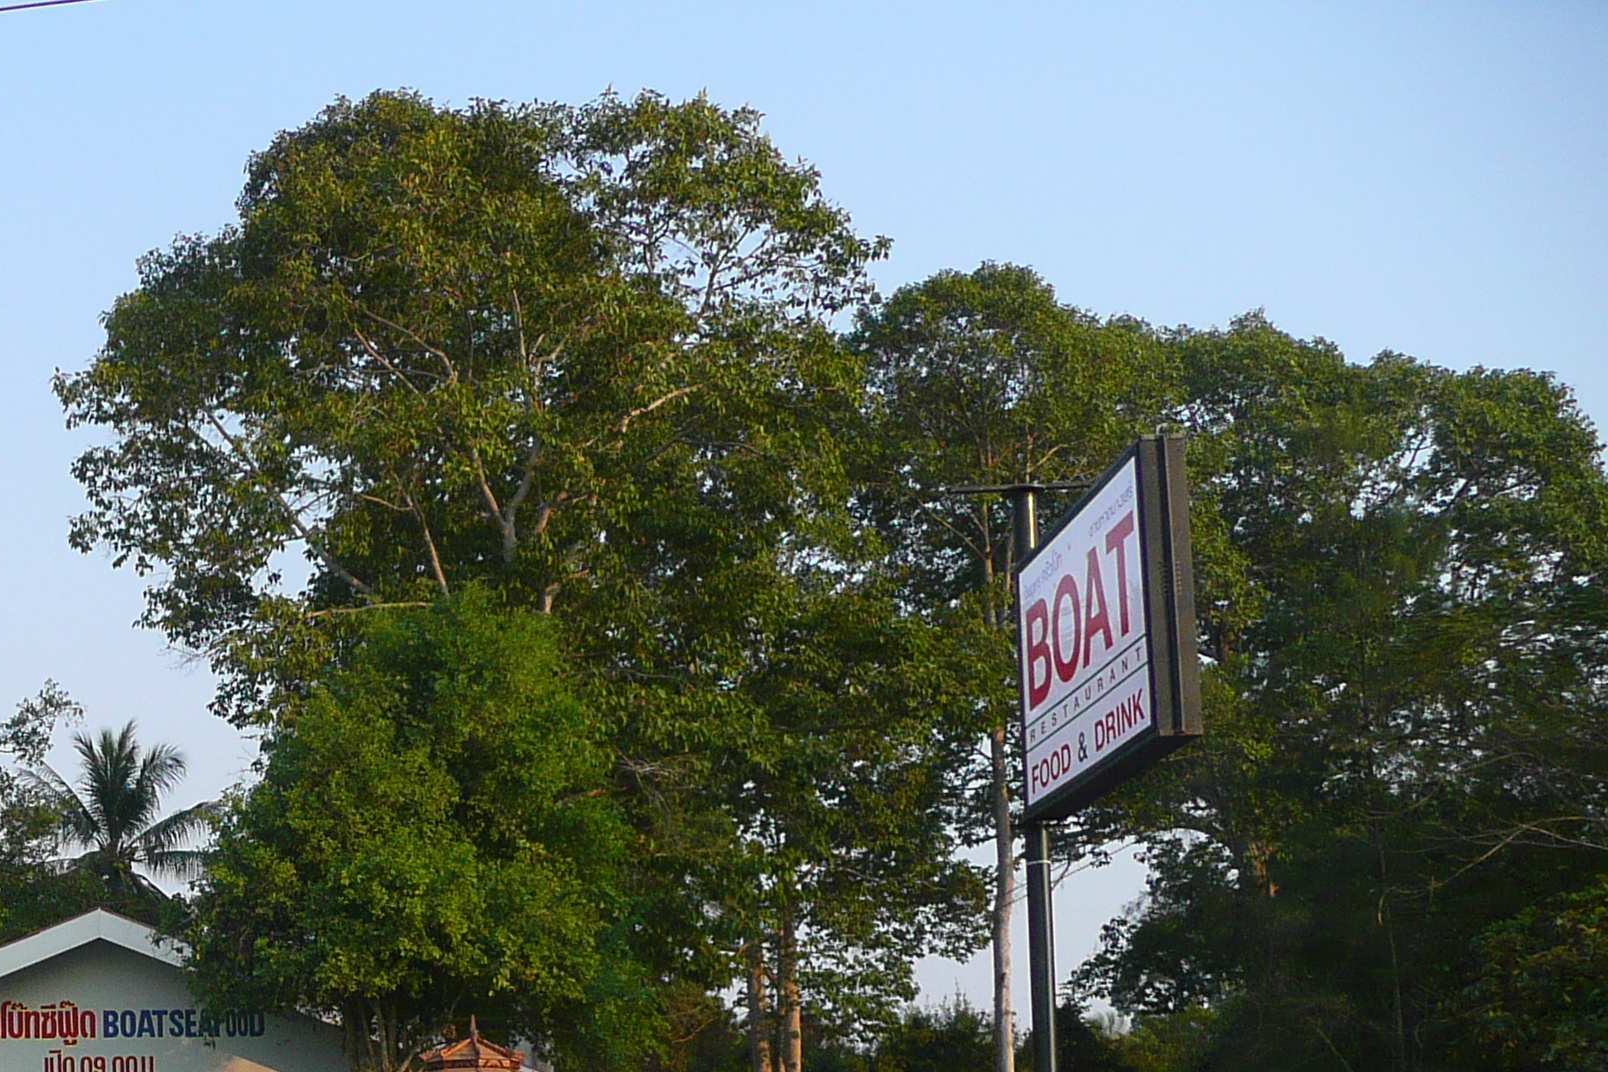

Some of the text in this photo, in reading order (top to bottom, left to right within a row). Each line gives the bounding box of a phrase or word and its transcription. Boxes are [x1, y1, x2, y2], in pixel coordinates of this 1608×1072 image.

[1026, 511, 1134, 711] BOAT
[1030, 646, 1142, 743] RESTAURANT
[1032, 688, 1145, 795] FOOD & DRINK
